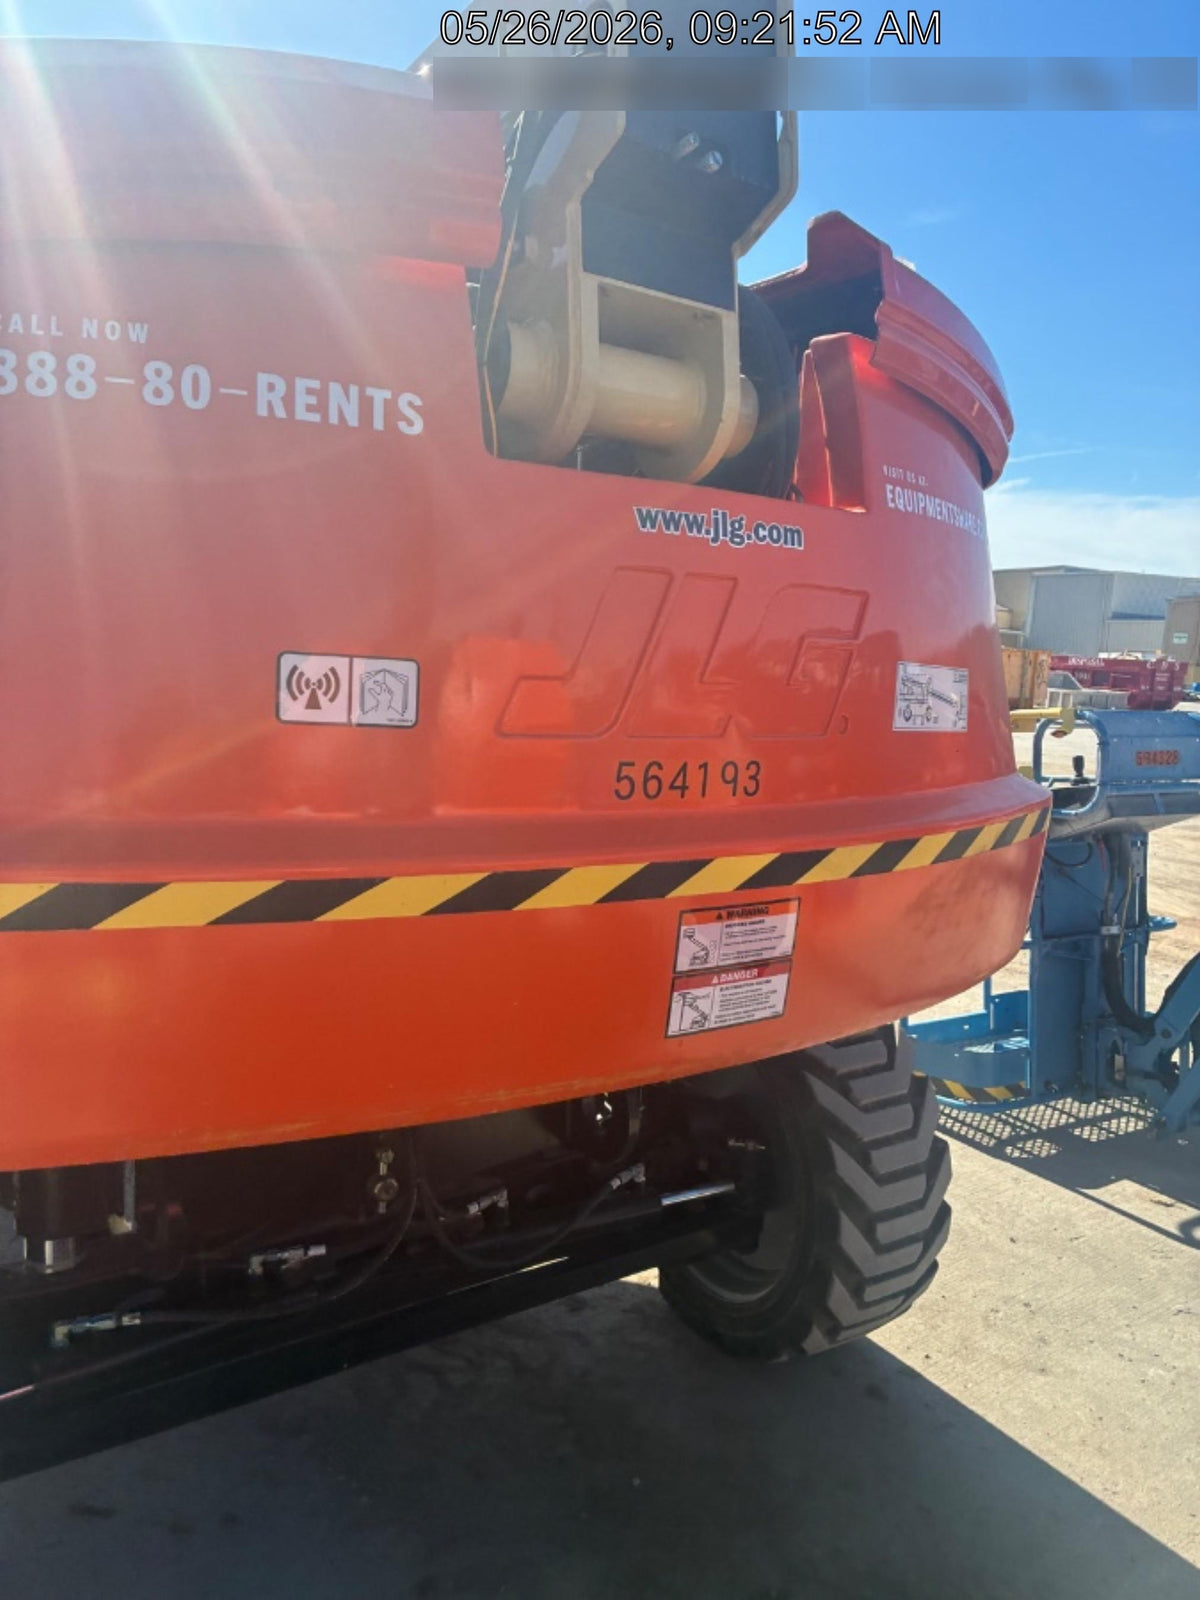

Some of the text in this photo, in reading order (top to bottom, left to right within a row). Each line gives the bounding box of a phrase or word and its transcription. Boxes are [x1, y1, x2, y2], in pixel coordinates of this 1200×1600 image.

[0, 312, 149, 344] ALL NOW
[633, 506, 804, 550] www.jlg.com
[614, 759, 762, 801] 564193
[719, 968, 759, 983] DANGER
